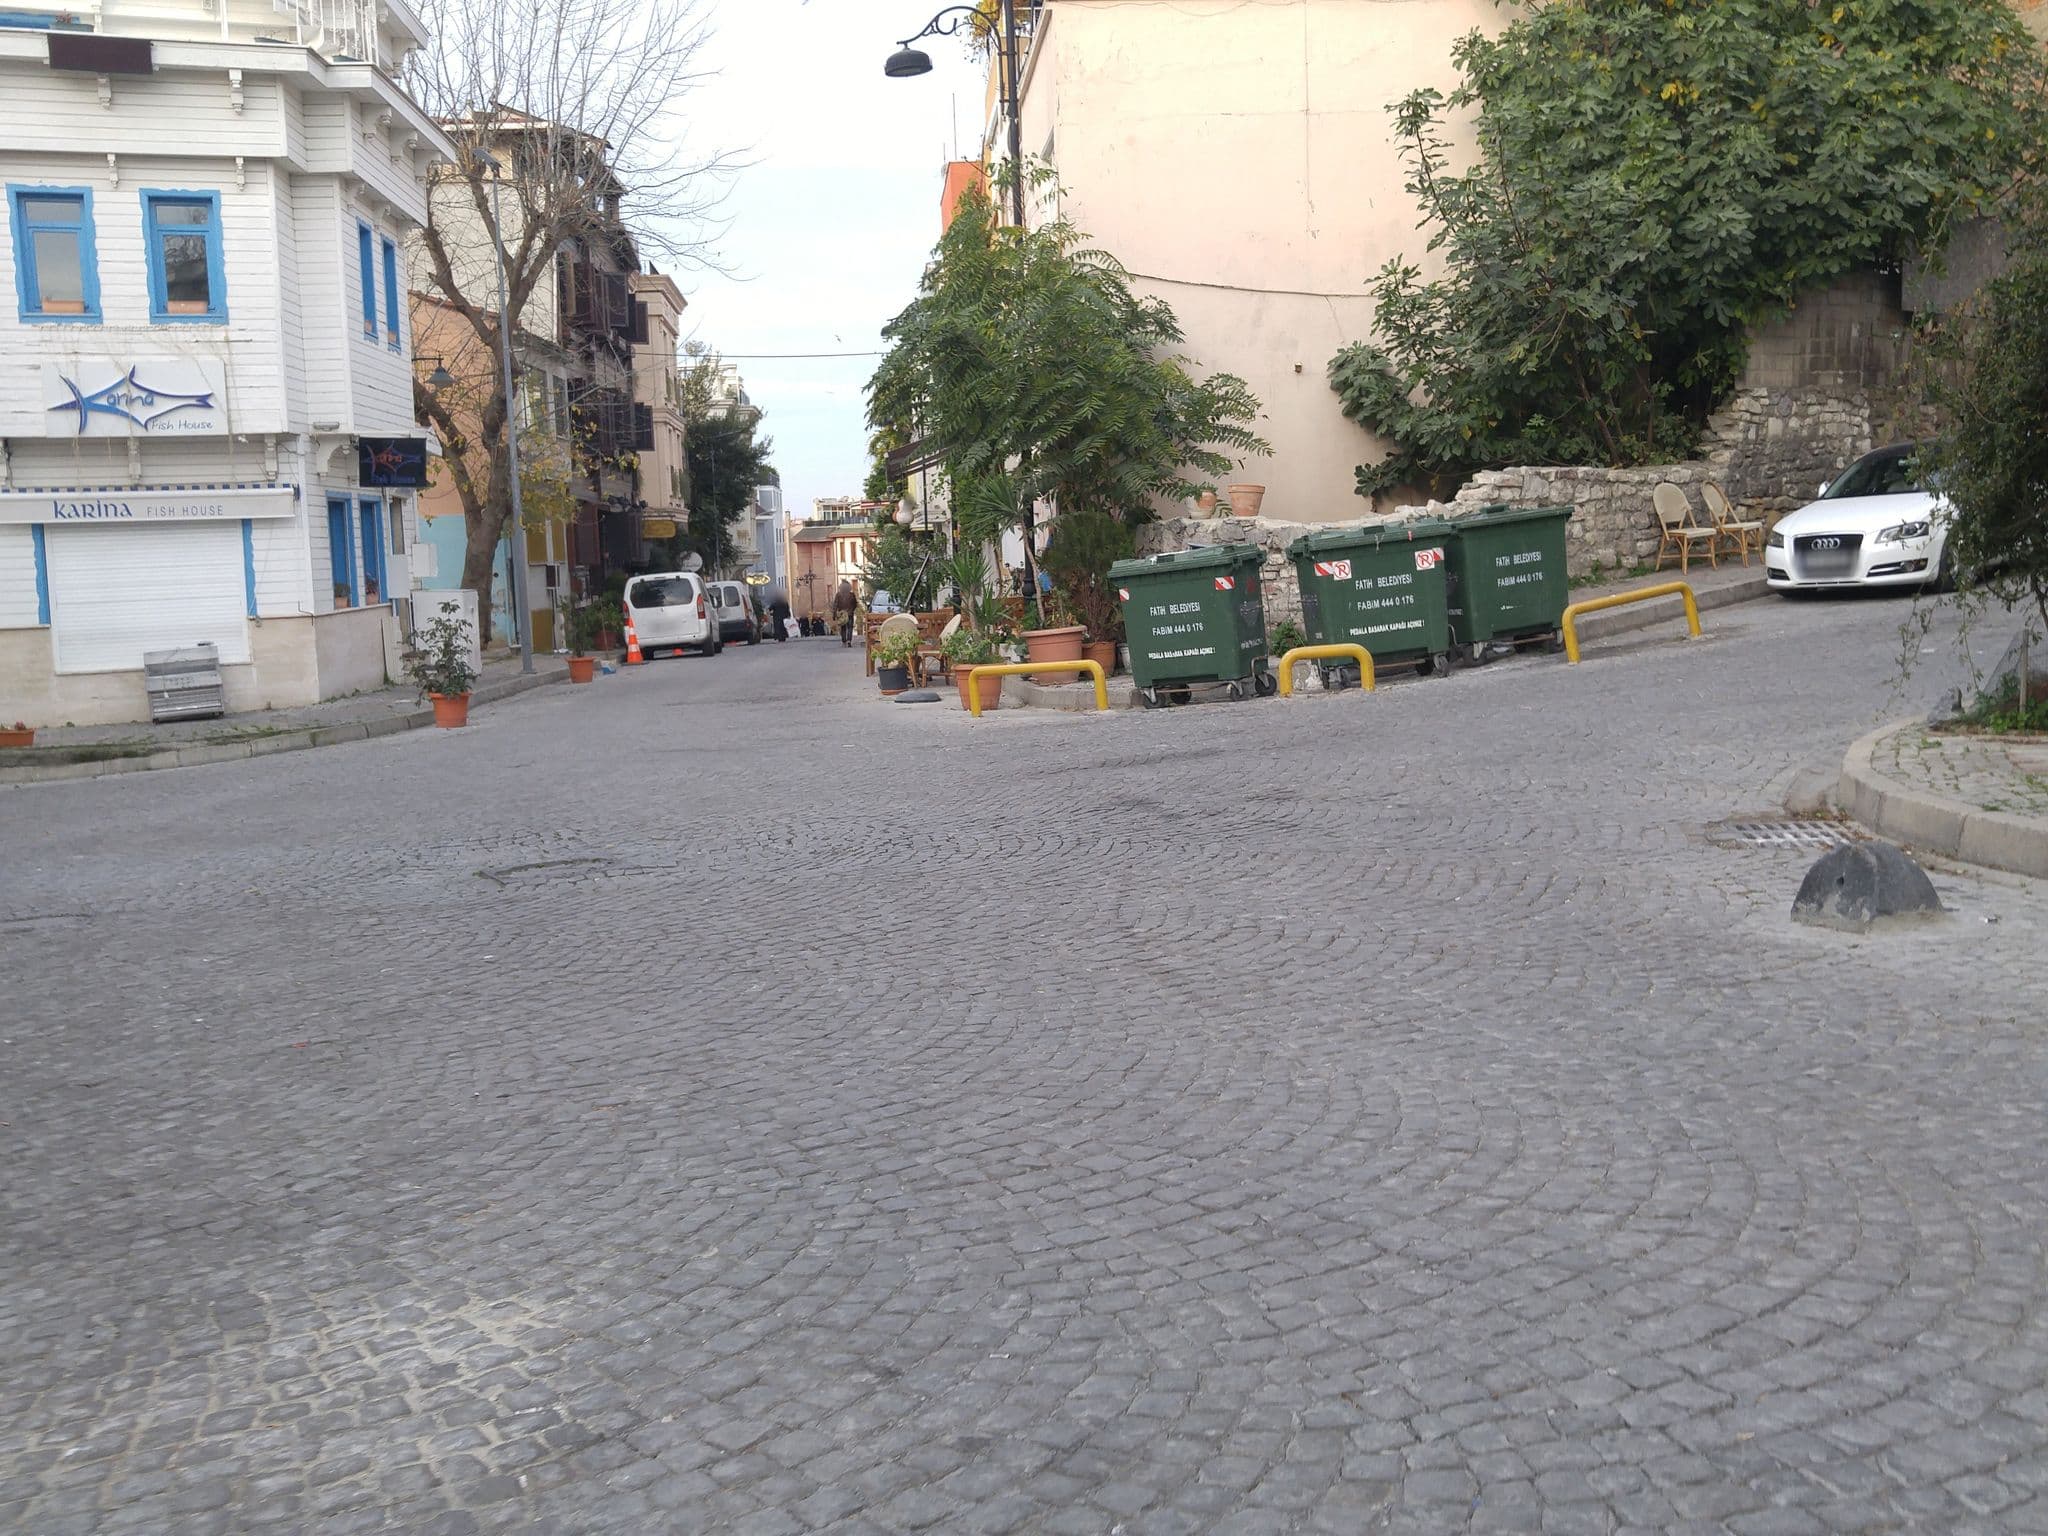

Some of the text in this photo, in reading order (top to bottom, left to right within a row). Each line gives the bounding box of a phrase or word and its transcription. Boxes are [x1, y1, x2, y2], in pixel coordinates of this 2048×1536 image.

[151, 419, 213, 430] Fish House
[147, 506, 175, 518] FISH
[182, 505, 224, 516] HOUSE
[1516, 574, 1526, 584] 444
[1532, 571, 1543, 581] 176
[1381, 598, 1394, 607] 444
[1395, 597, 1400, 606] 0
[1401, 595, 1414, 604] 176
[1174, 624, 1186, 633] 444
[1186, 623, 1191, 632] 0
[1192, 622, 1204, 631] 176
